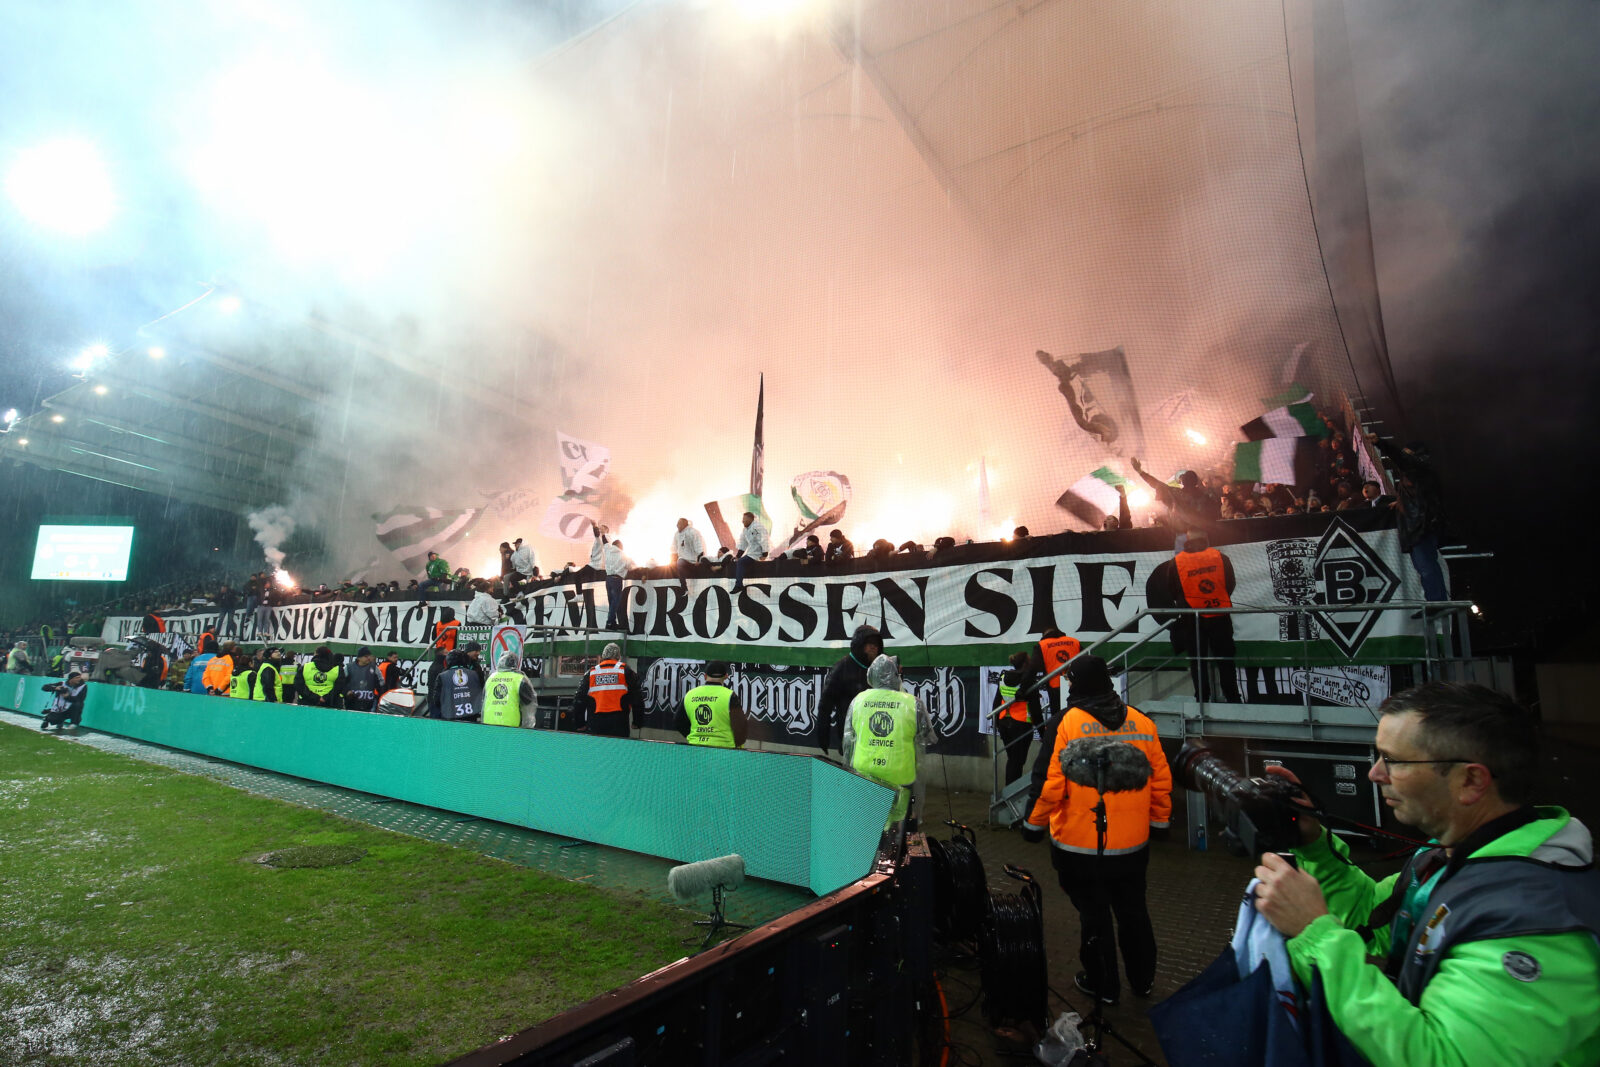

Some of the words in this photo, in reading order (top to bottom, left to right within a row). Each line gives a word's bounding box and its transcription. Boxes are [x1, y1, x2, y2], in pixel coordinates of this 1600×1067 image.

[619, 576, 930, 642] GROSSEN
[964, 560, 1141, 639] SIE
[1204, 598, 1221, 608] 25
[352, 689, 374, 700] OTO
[455, 702, 473, 716] 38
[864, 701, 900, 709] SICHERHEIT
[1081, 720, 1138, 735] ORDER
[869, 739, 894, 747] SERVICE
[873, 758, 886, 766] 199
